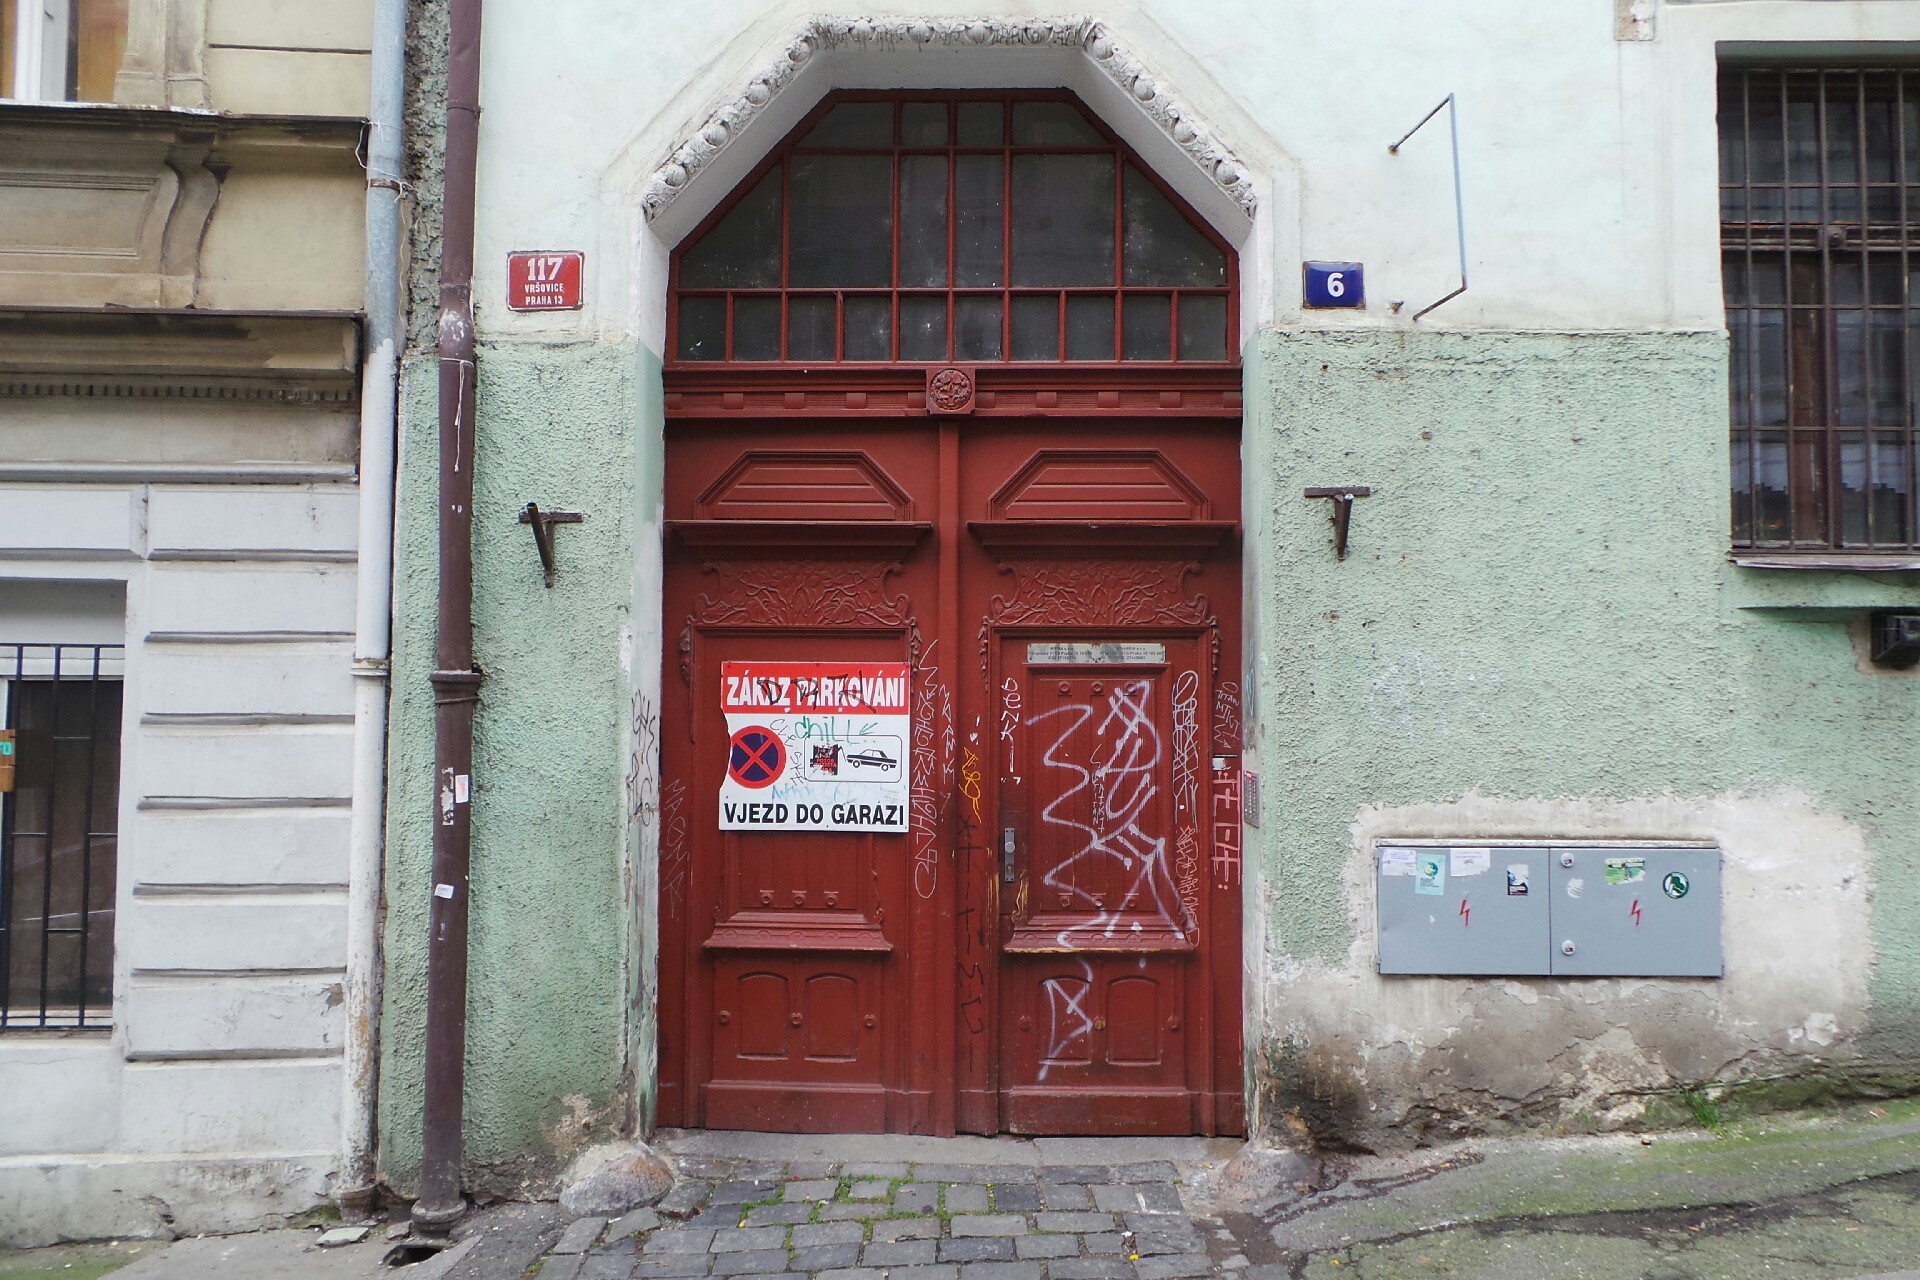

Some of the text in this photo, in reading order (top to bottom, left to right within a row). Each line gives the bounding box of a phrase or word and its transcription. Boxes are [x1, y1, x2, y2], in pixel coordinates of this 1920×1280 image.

[527, 257, 563, 281] 117
[524, 282, 565, 293] VRŠOVICE
[1327, 272, 1345, 298] 6
[525, 295, 563, 305] PRAHA 13
[726, 669, 906, 708] ZÁKAZ PARKOVÁNÍ
[724, 803, 789, 823] VJEZD
[796, 803, 824, 824] DO
